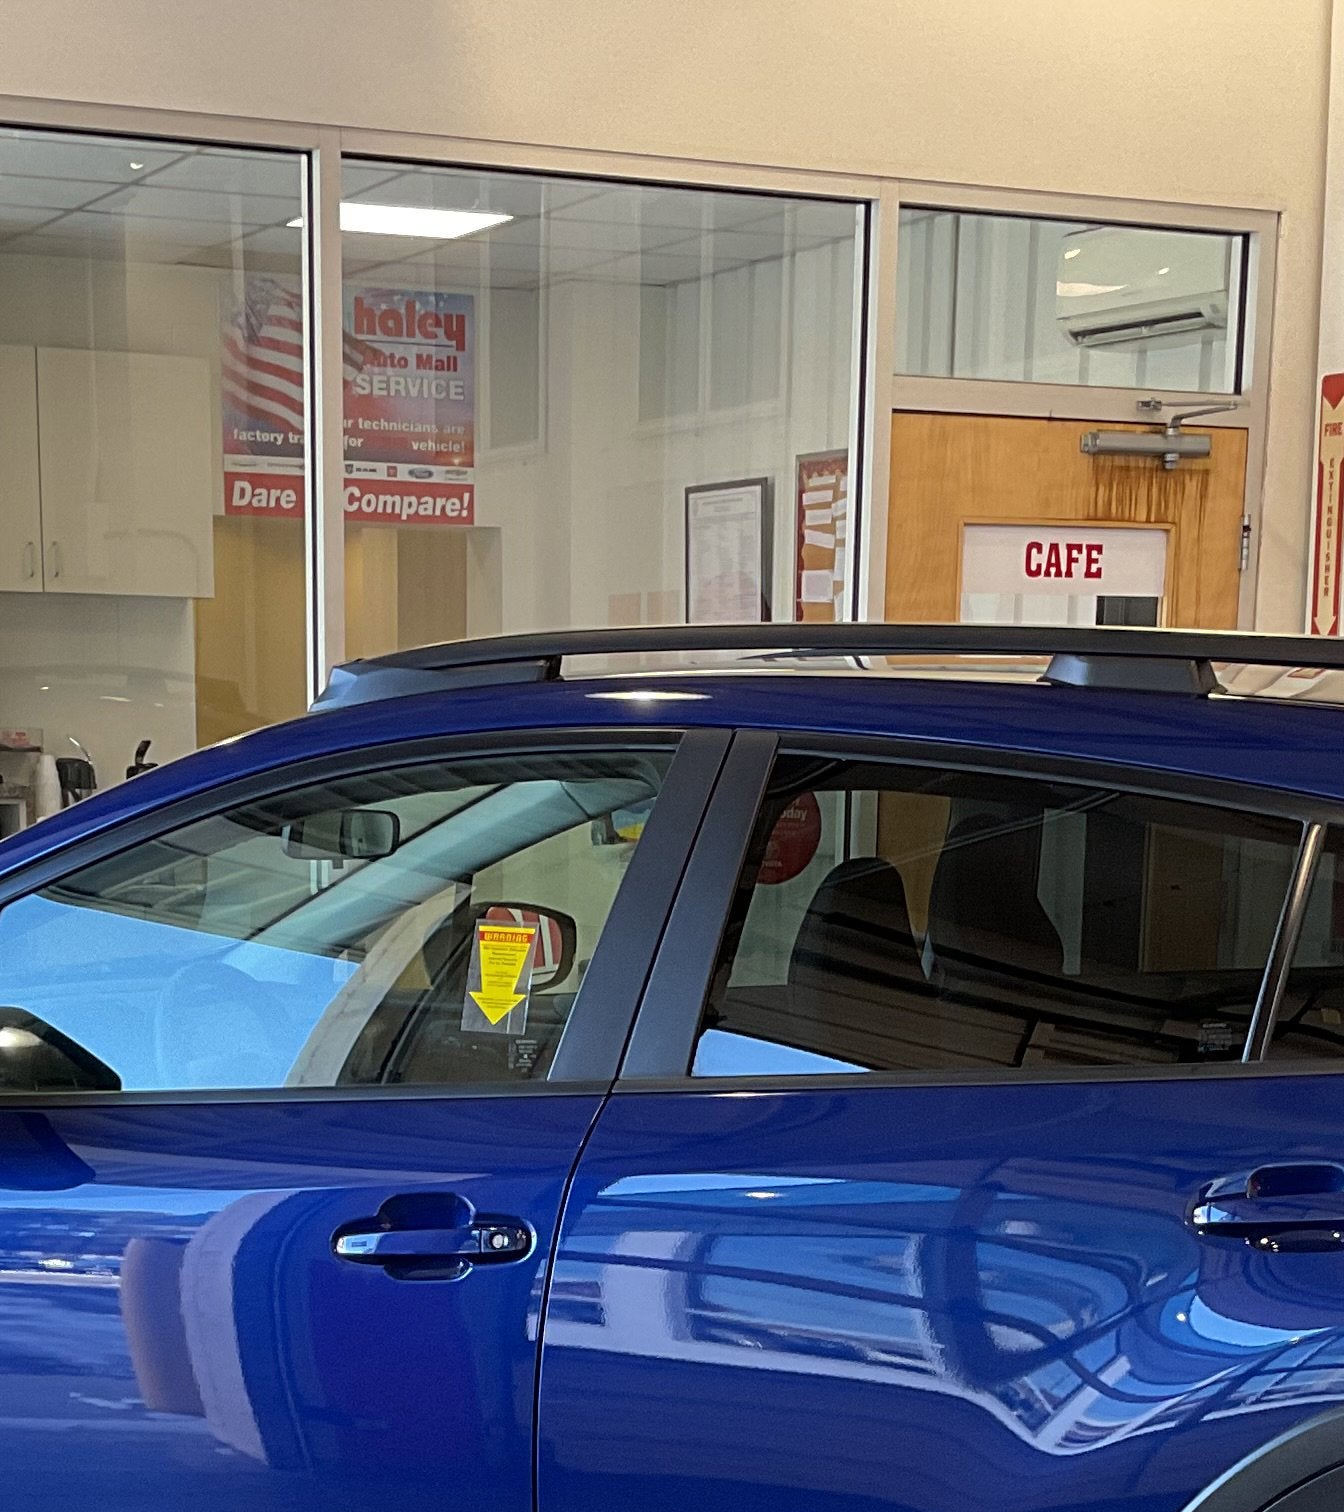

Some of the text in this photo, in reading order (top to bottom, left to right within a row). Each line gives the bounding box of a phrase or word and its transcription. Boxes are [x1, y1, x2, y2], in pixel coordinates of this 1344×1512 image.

[354, 296, 466, 352] haley
[416, 353, 458, 372] Mall
[353, 374, 465, 401] SERVICE
[358, 417, 438, 433] technicians
[442, 424, 465, 435] are
[1323, 421, 1344, 438] FIRE
[233, 428, 284, 446] factory
[411, 439, 465, 453] vehicle!
[231, 480, 471, 521] Dare Compare!
[1323, 457, 1335, 597] EXTINGUISHER
[1024, 540, 1104, 579] CAFE
[779, 806, 809, 822] oday
[483, 931, 529, 944] WARNING
